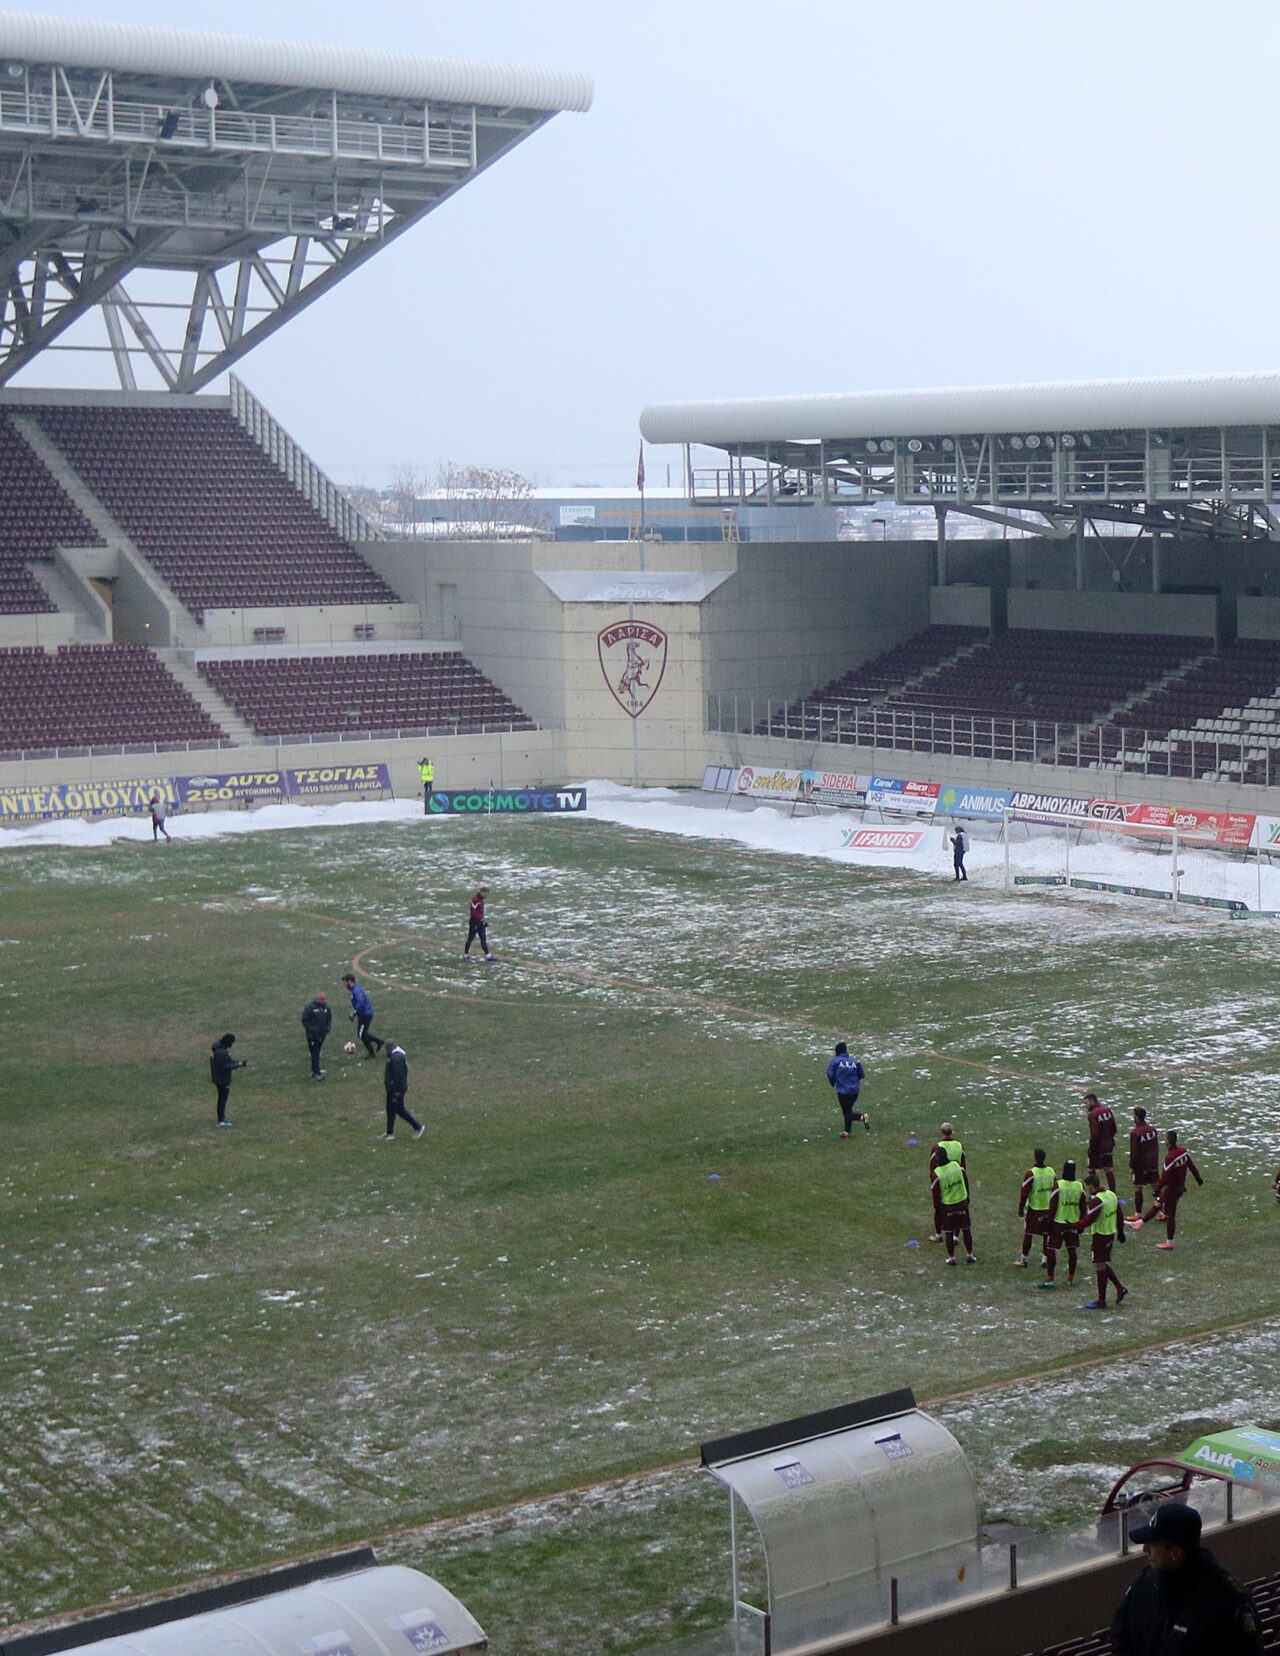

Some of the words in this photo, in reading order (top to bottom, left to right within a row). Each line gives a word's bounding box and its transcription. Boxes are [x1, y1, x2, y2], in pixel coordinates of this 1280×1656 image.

[607, 627, 658, 645] ΛΑΡΙΣΑ
[225, 772, 280, 788] AUTO
[294, 766, 379, 784] ΤΣΟΓΙΑΣ
[821, 773, 859, 789] SIDERAL
[186, 787, 234, 802] 250
[452, 793, 556, 810] COSMOTE
[556, 792, 582, 808] TV
[959, 794, 1005, 812] ANIMUS
[1010, 793, 1088, 815] ΑΒΡΑΜΟΥΛΗΣ
[887, 1448, 912, 1459] nova
[787, 1476, 813, 1487] nova
[416, 1637, 448, 1651] nova
